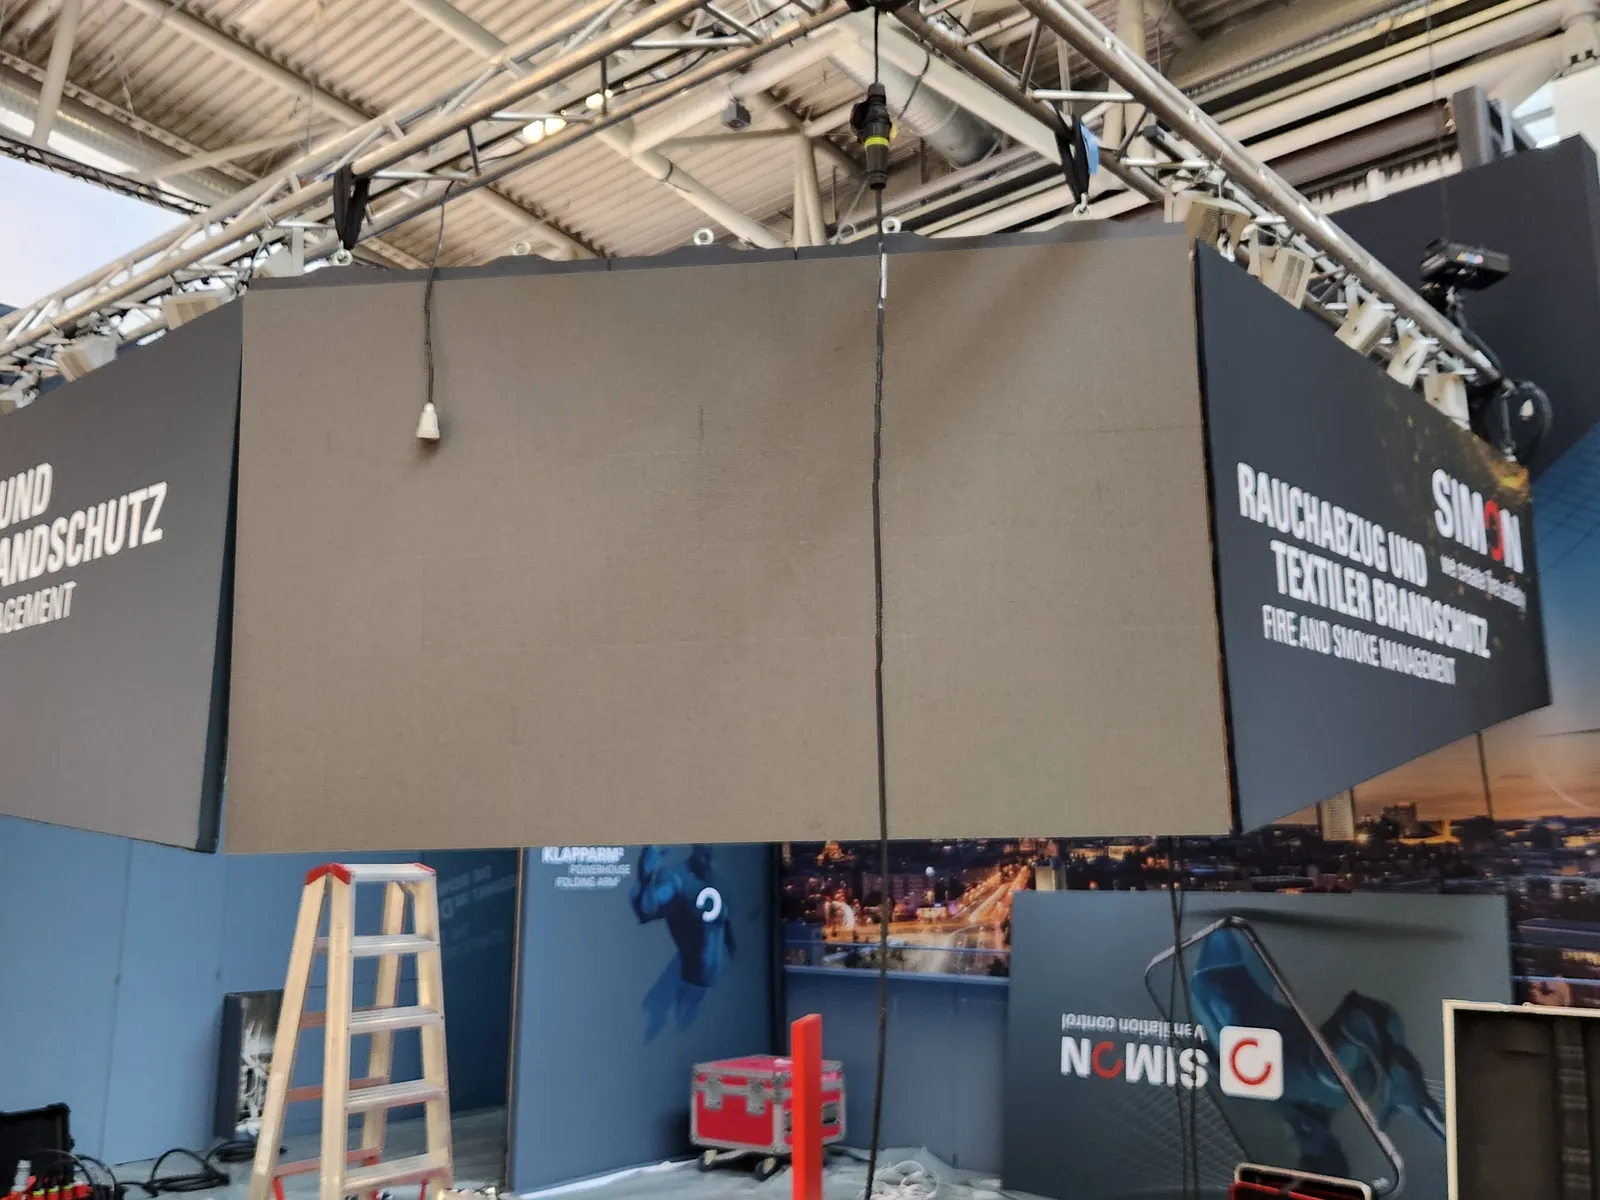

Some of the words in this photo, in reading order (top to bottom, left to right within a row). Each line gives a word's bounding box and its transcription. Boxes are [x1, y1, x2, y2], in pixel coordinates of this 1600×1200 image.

[0, 462, 53, 530] UND
[1236, 461, 1388, 573] RAUCHABZUG
[1388, 531, 1428, 588] UND
[1431, 468, 1524, 574] SIMON
[1270, 539, 1373, 622] TEXTILER
[1372, 577, 1491, 660] BRANDSCHUTZ
[1262, 604, 1299, 648] FIRE
[1299, 614, 1332, 656] AND
[1332, 624, 1379, 668] SMOKE
[1379, 638, 1456, 686] MANAGEMENT
[1060, 1036, 1210, 1090] SIMON
[1061, 1013, 1117, 1031] control
